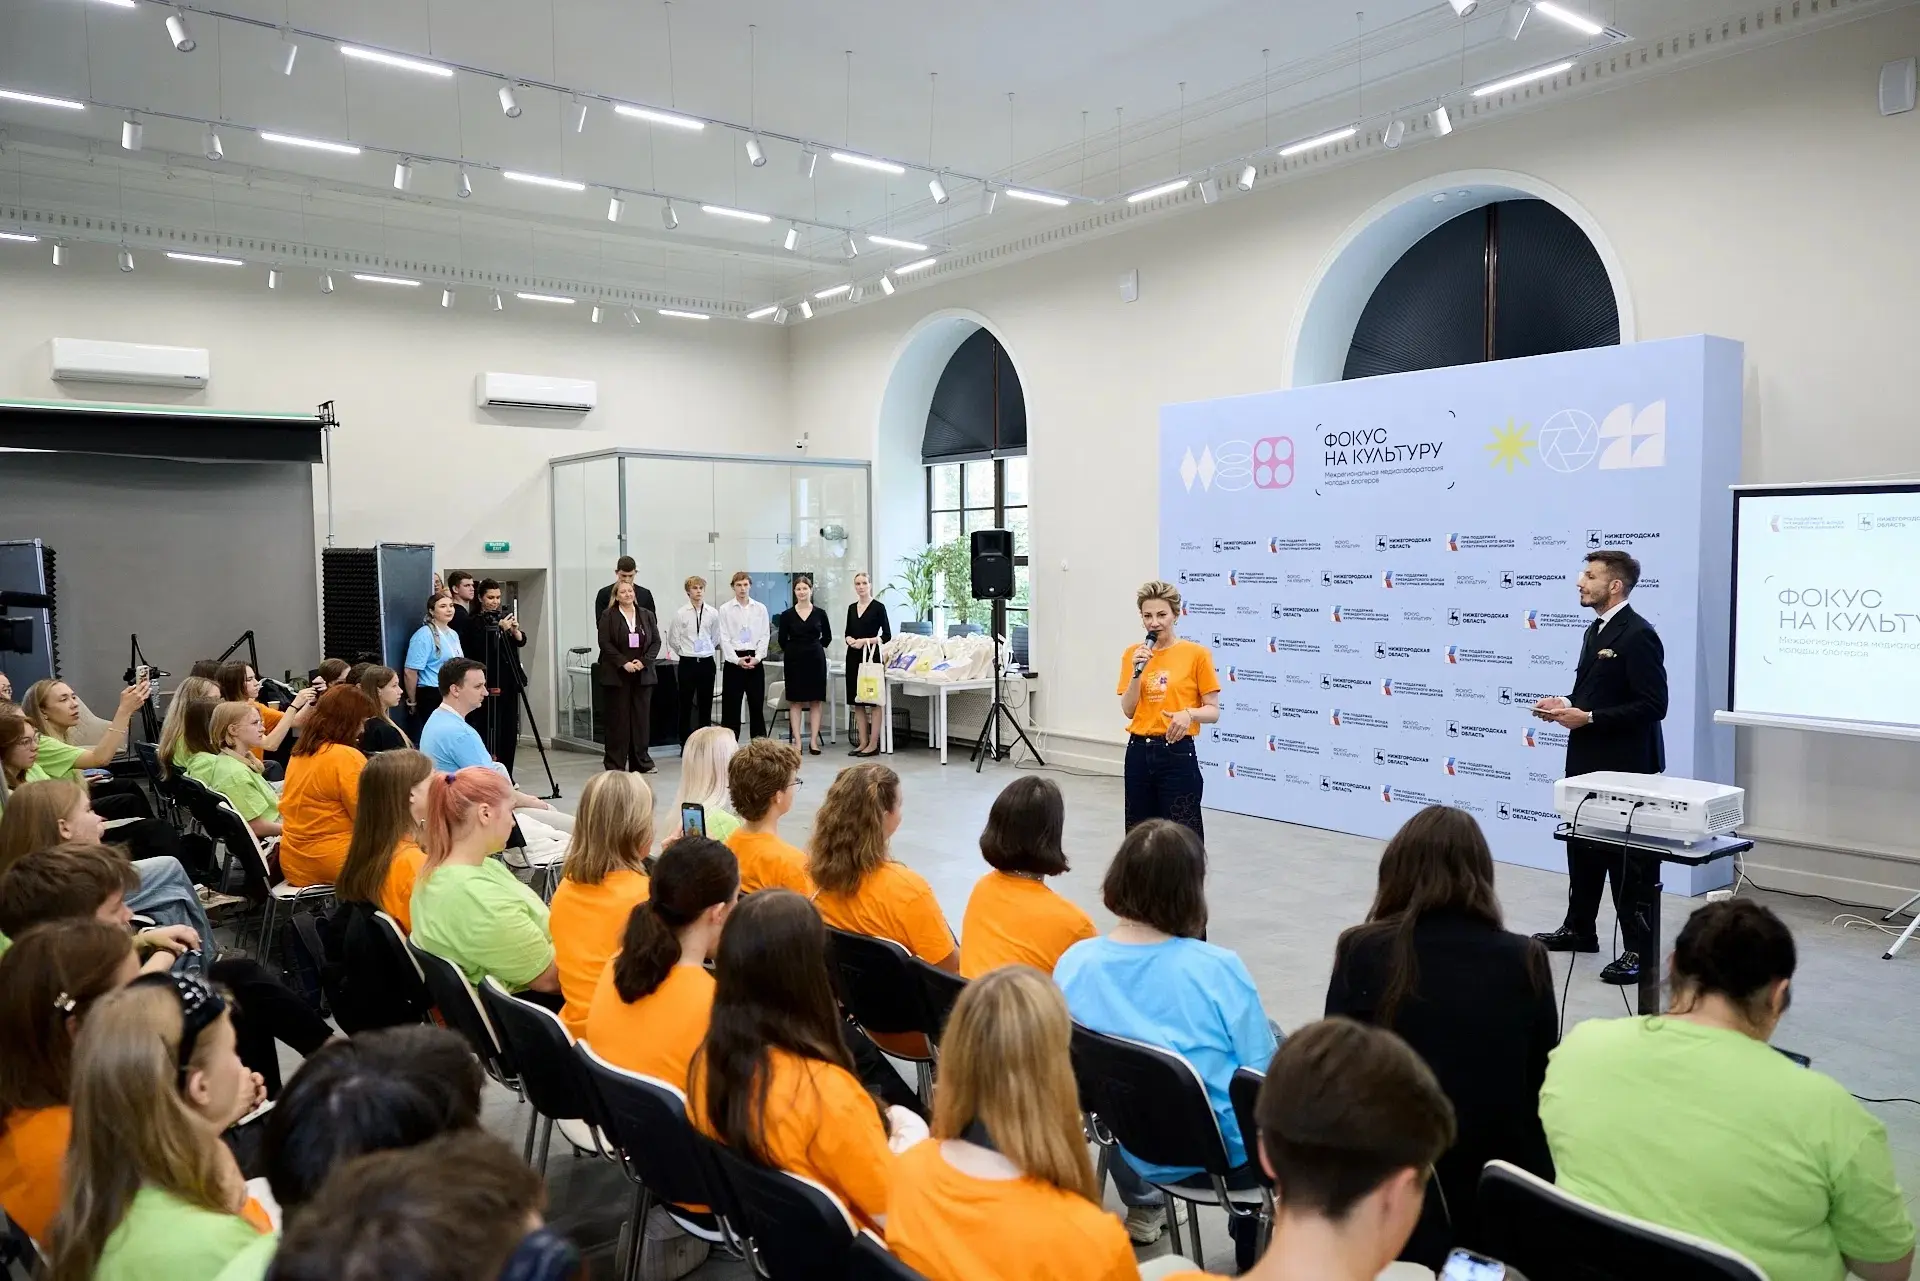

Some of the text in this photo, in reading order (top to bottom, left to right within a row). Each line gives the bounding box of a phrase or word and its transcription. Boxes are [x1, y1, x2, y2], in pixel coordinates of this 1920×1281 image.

[1324, 428, 1387, 447] ФОКУС
[1325, 442, 1443, 466] НА КУЛЬТУРУ
[1325, 465, 1444, 478] Межрегиональная медиалаборатория
[1779, 588, 1882, 608] ФОКУС
[1780, 611, 1920, 633] НА КУЛЬТ
[1779, 636, 1920, 650] Межрегиональная медиалаб
[1822, 648, 1868, 657] блогеров
[1513, 808, 1561, 819] НИЖЕГОРОДСКАЯ
